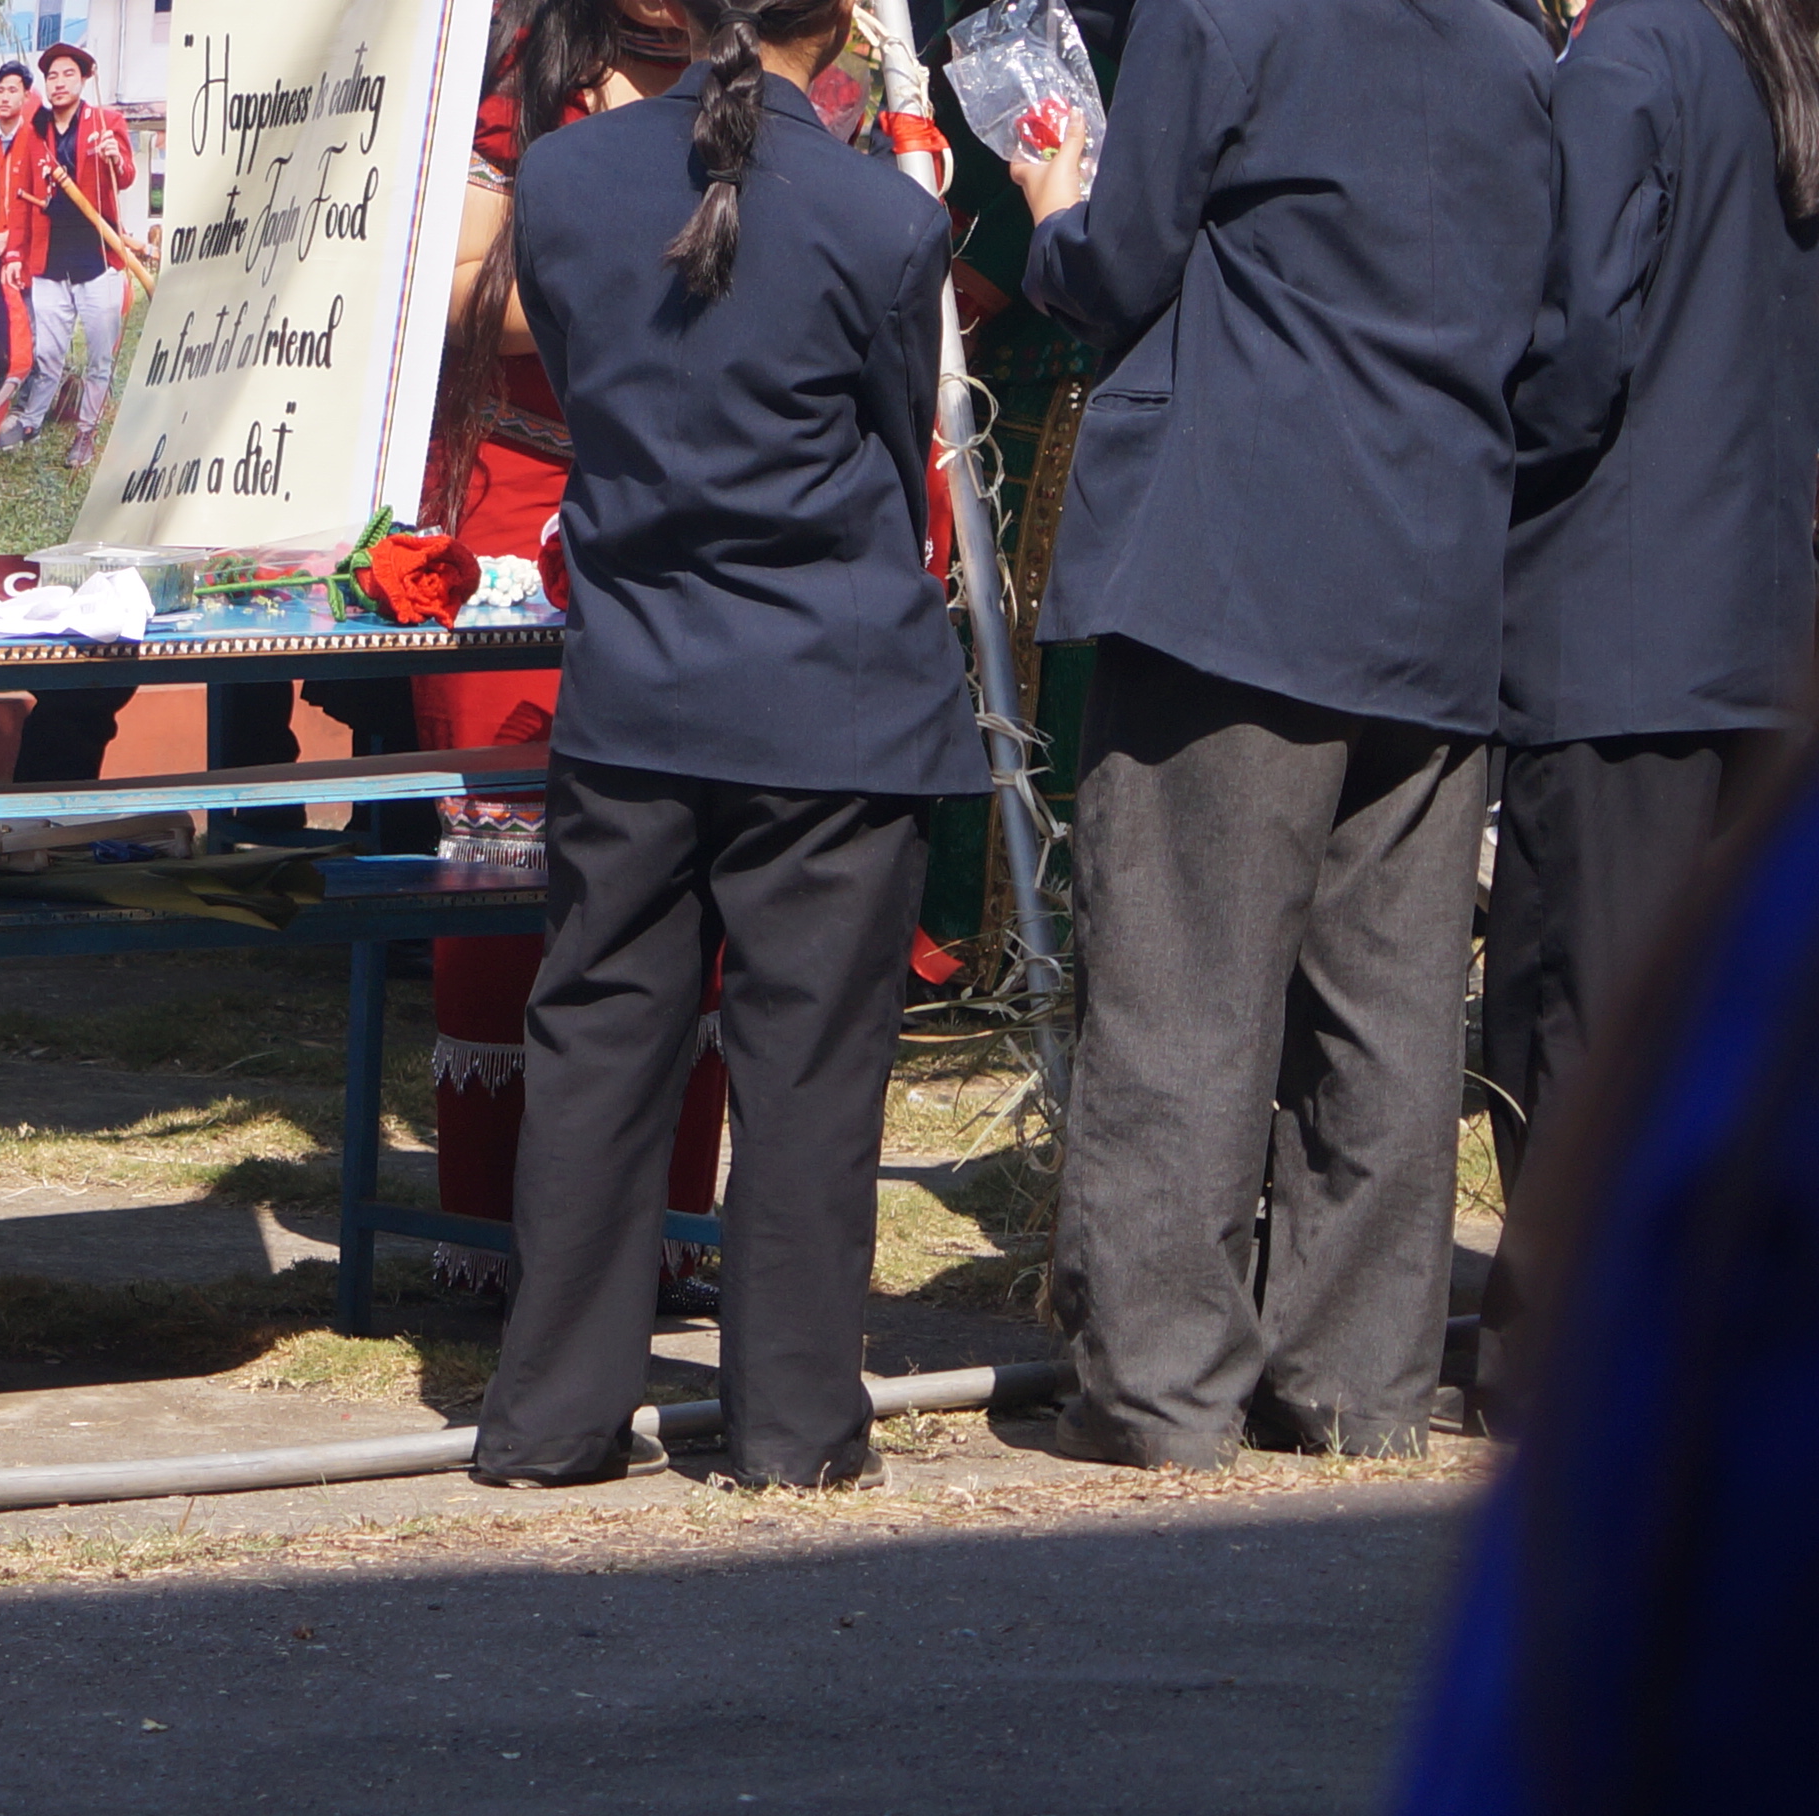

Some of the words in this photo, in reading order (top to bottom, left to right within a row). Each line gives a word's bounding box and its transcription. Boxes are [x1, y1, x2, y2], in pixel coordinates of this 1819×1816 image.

[312, 71, 329, 122] is
[328, 41, 386, 155] eating
[170, 225, 197, 265] an
[199, 185, 249, 258] entire
[297, 141, 379, 262] Food
[145, 338, 169, 387] in
[169, 304, 229, 383] front
[215, 300, 249, 374] of
[236, 333, 255, 369] a
[252, 293, 344, 369] friend
[176, 456, 201, 496] on
[207, 457, 225, 495] a
